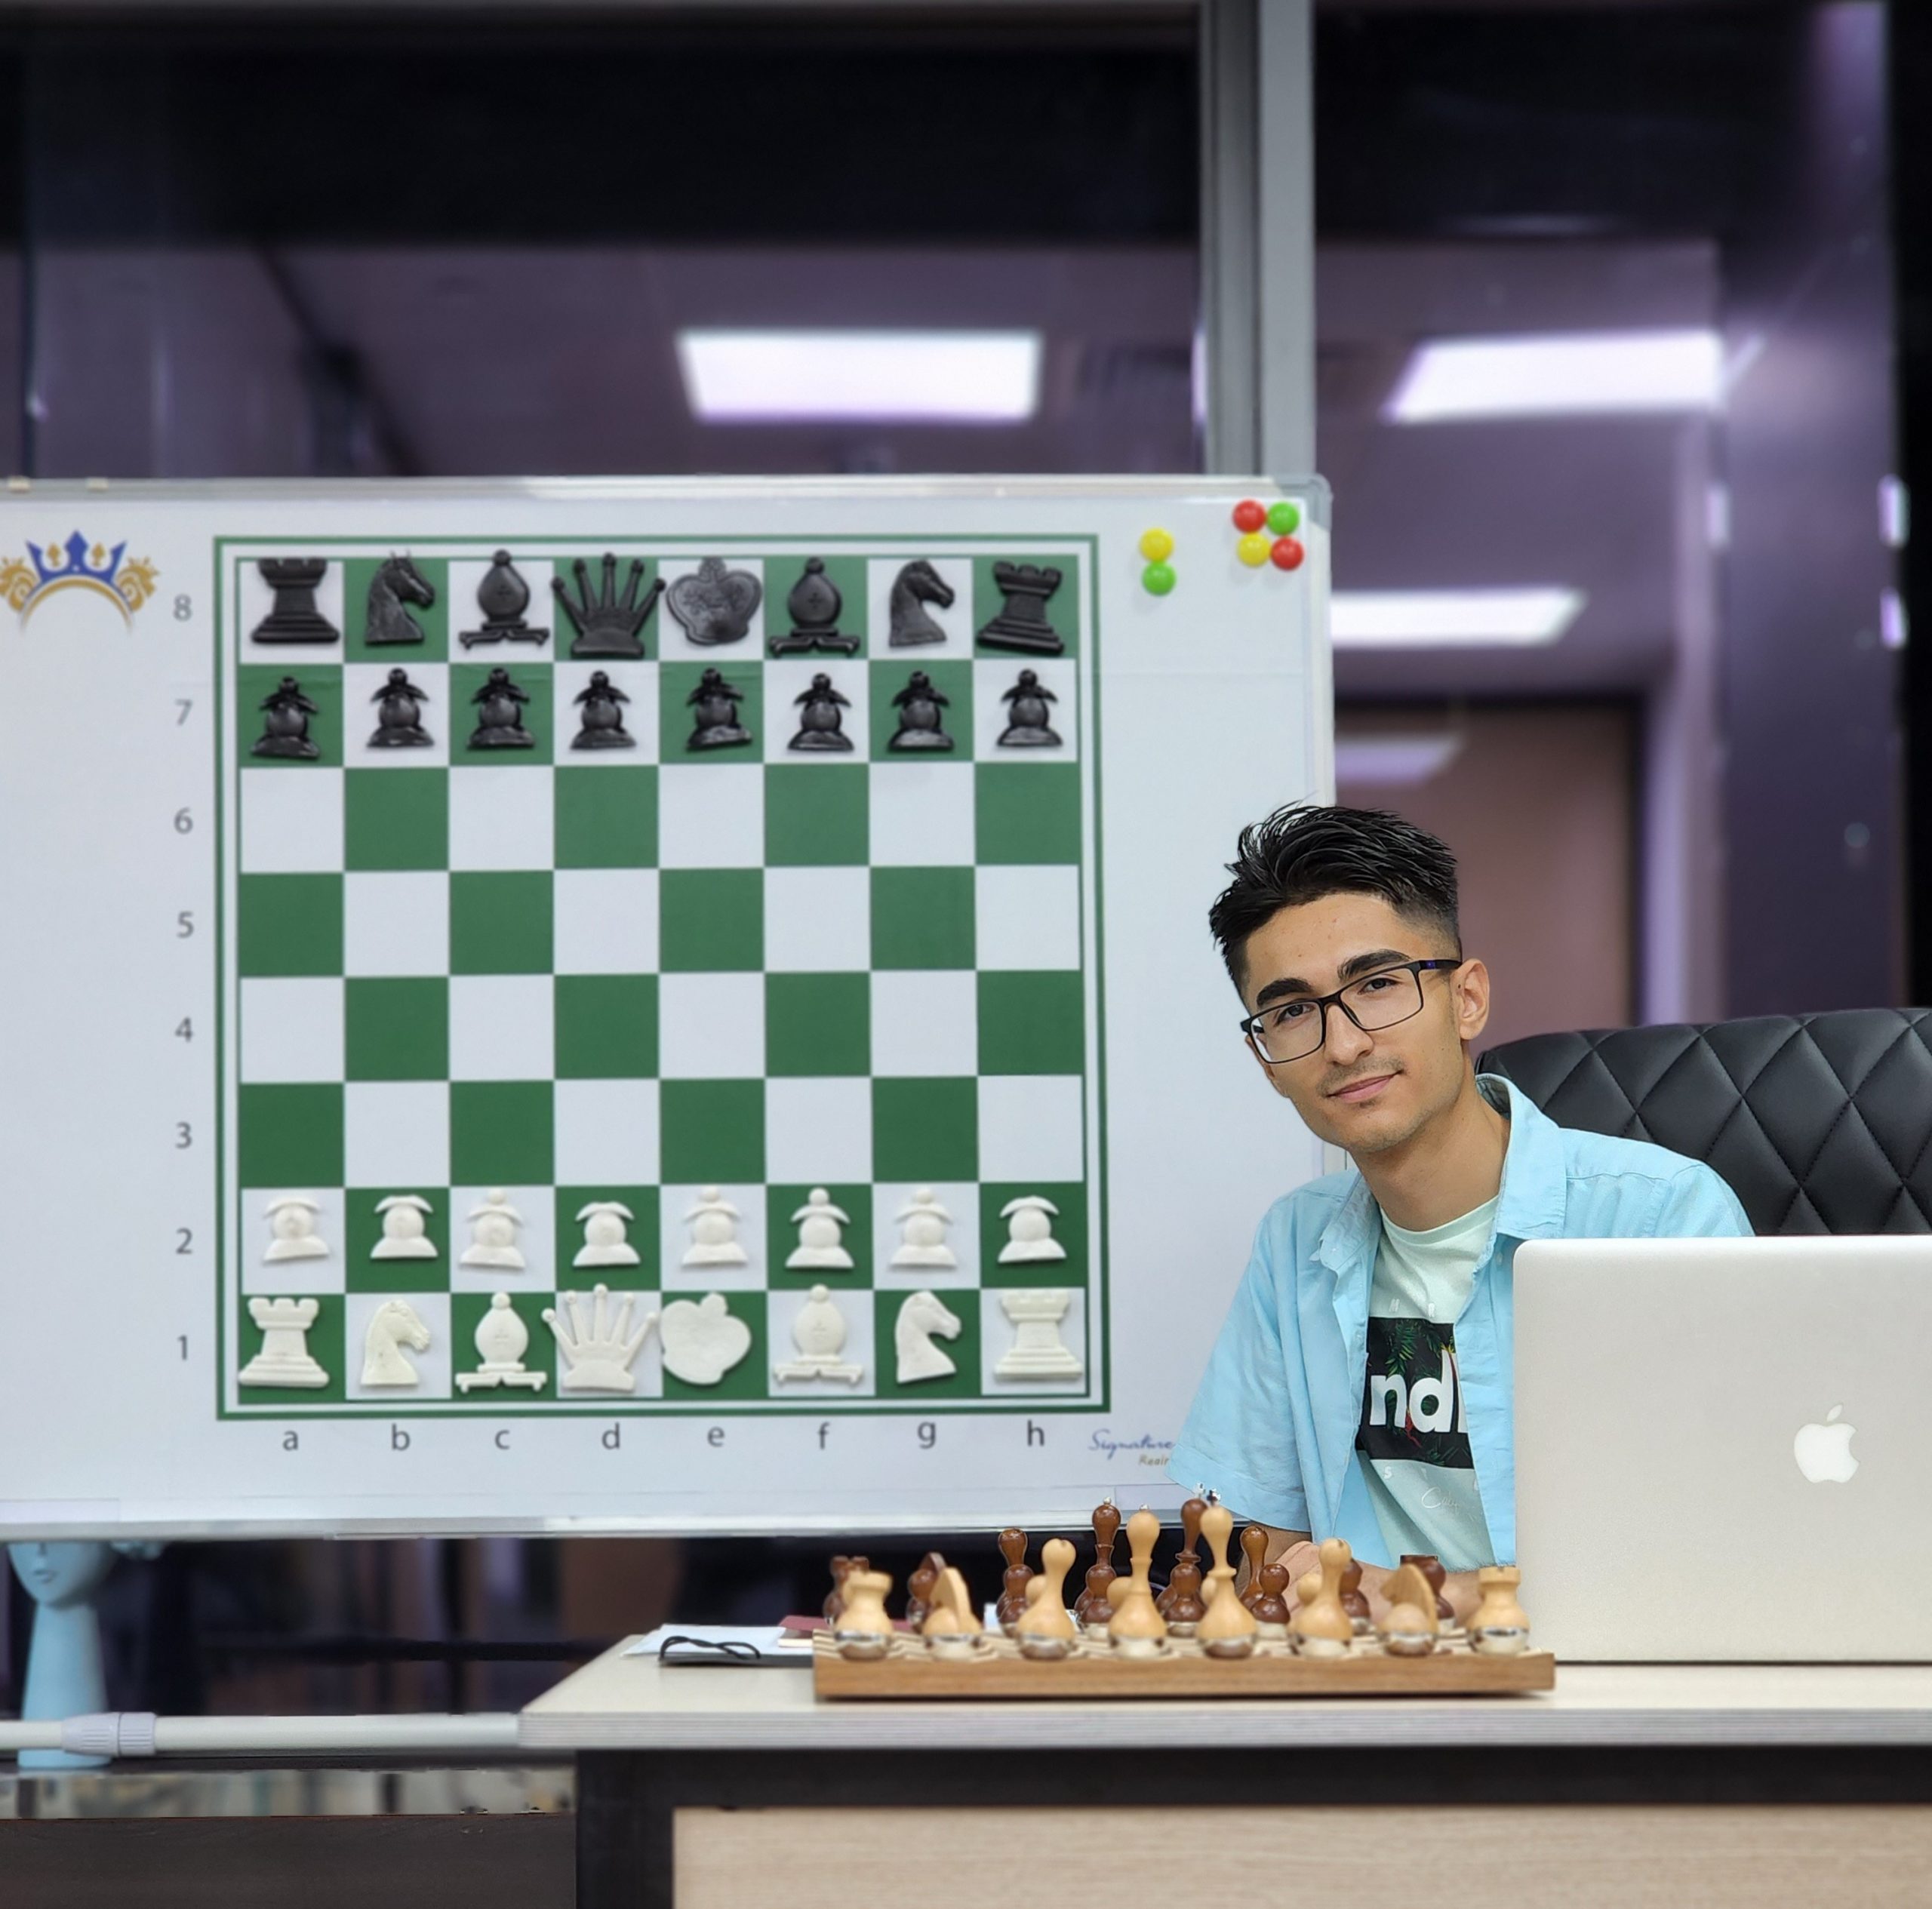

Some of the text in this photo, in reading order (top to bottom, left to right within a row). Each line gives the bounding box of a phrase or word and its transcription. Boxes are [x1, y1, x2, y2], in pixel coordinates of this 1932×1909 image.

[173, 594, 192, 622] 8
[175, 699, 193, 726] 7
[174, 807, 193, 835] 6
[177, 911, 194, 939] 5
[174, 1017, 194, 1042] 4
[176, 1121, 192, 1149] 3
[176, 1228, 192, 1255] 2
[178, 1335, 188, 1361] 1
[282, 1430, 300, 1452] a
[392, 1423, 411, 1451] b
[494, 1429, 510, 1450] c
[601, 1422, 620, 1449] d
[707, 1427, 725, 1447] e
[817, 1422, 829, 1449] f
[917, 1422, 937, 1449] g
[1027, 1420, 1044, 1446] h
[1088, 1428, 1174, 1461] Signature
